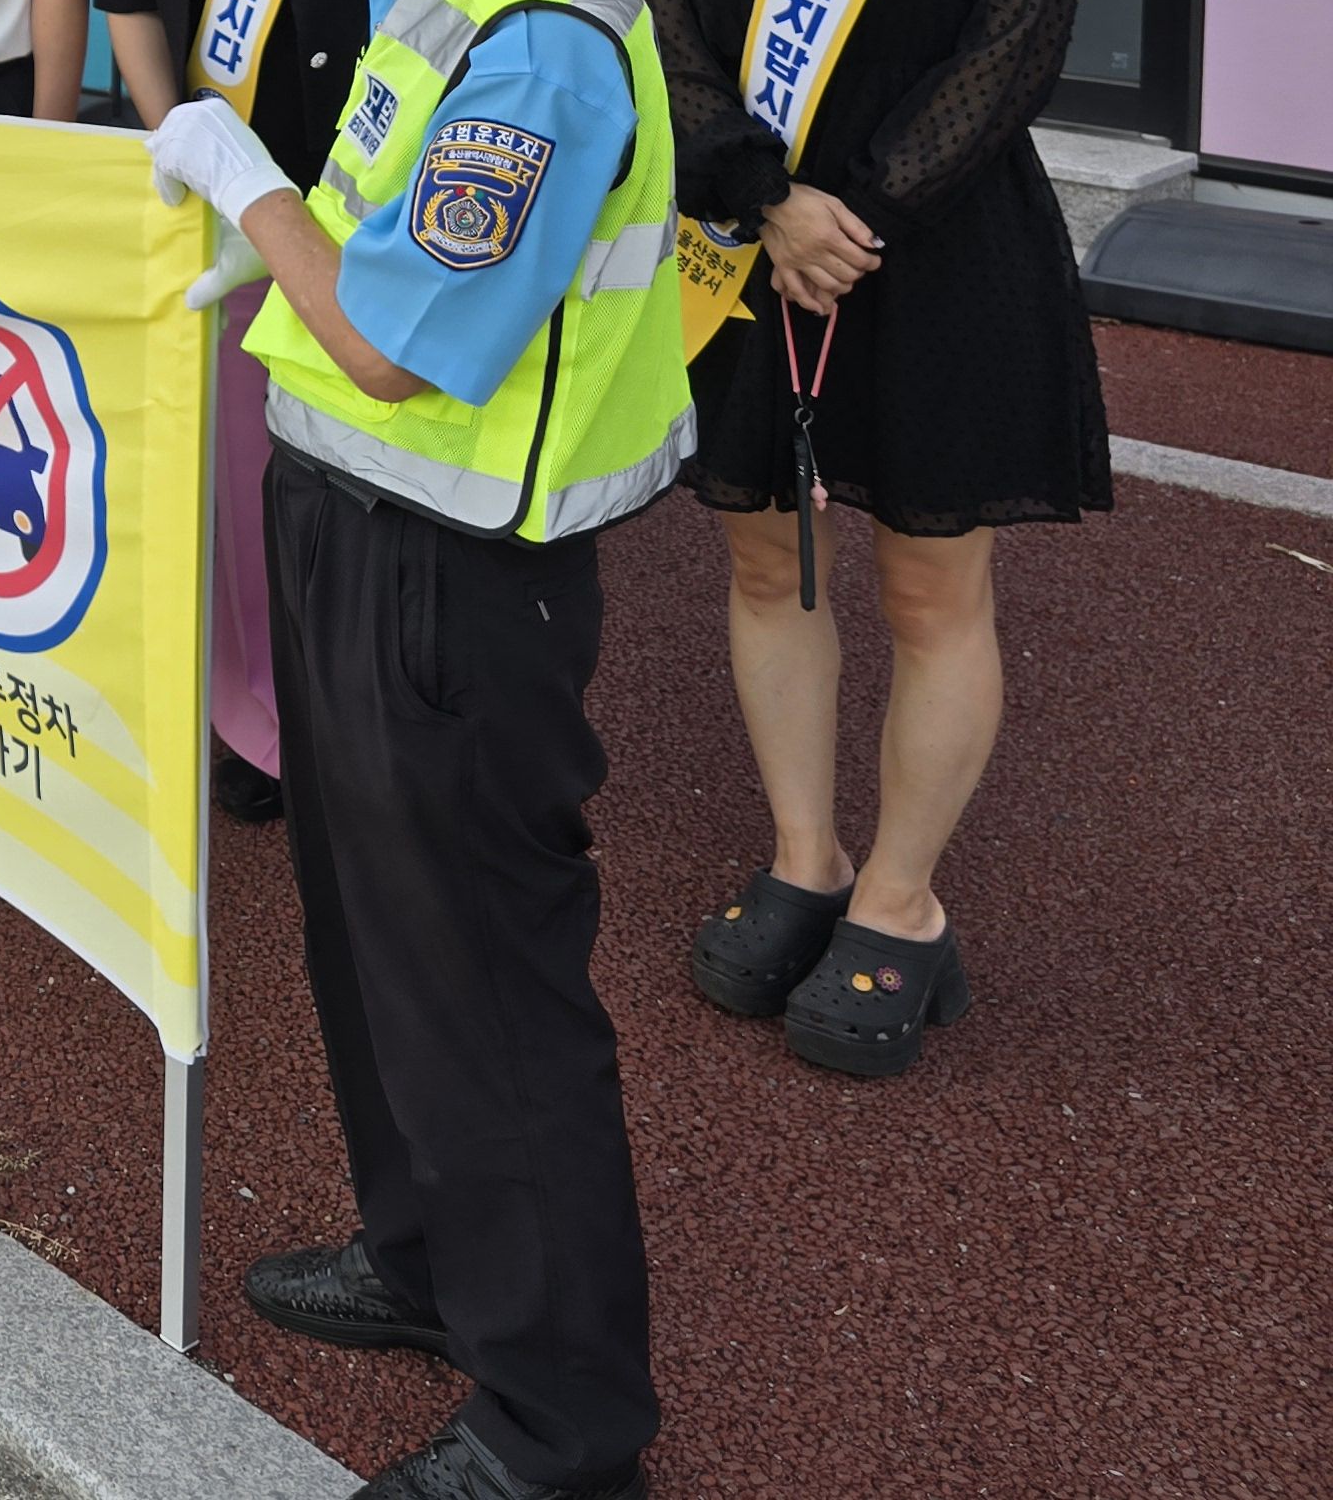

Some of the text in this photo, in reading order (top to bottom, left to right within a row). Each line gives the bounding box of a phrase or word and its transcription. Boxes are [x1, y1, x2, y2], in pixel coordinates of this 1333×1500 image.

[360, 77, 398, 136] 모범
[436, 124, 541, 160] 모범운전자
[676, 251, 723, 297] 경찰서
[677, 229, 737, 279] 울산중부
